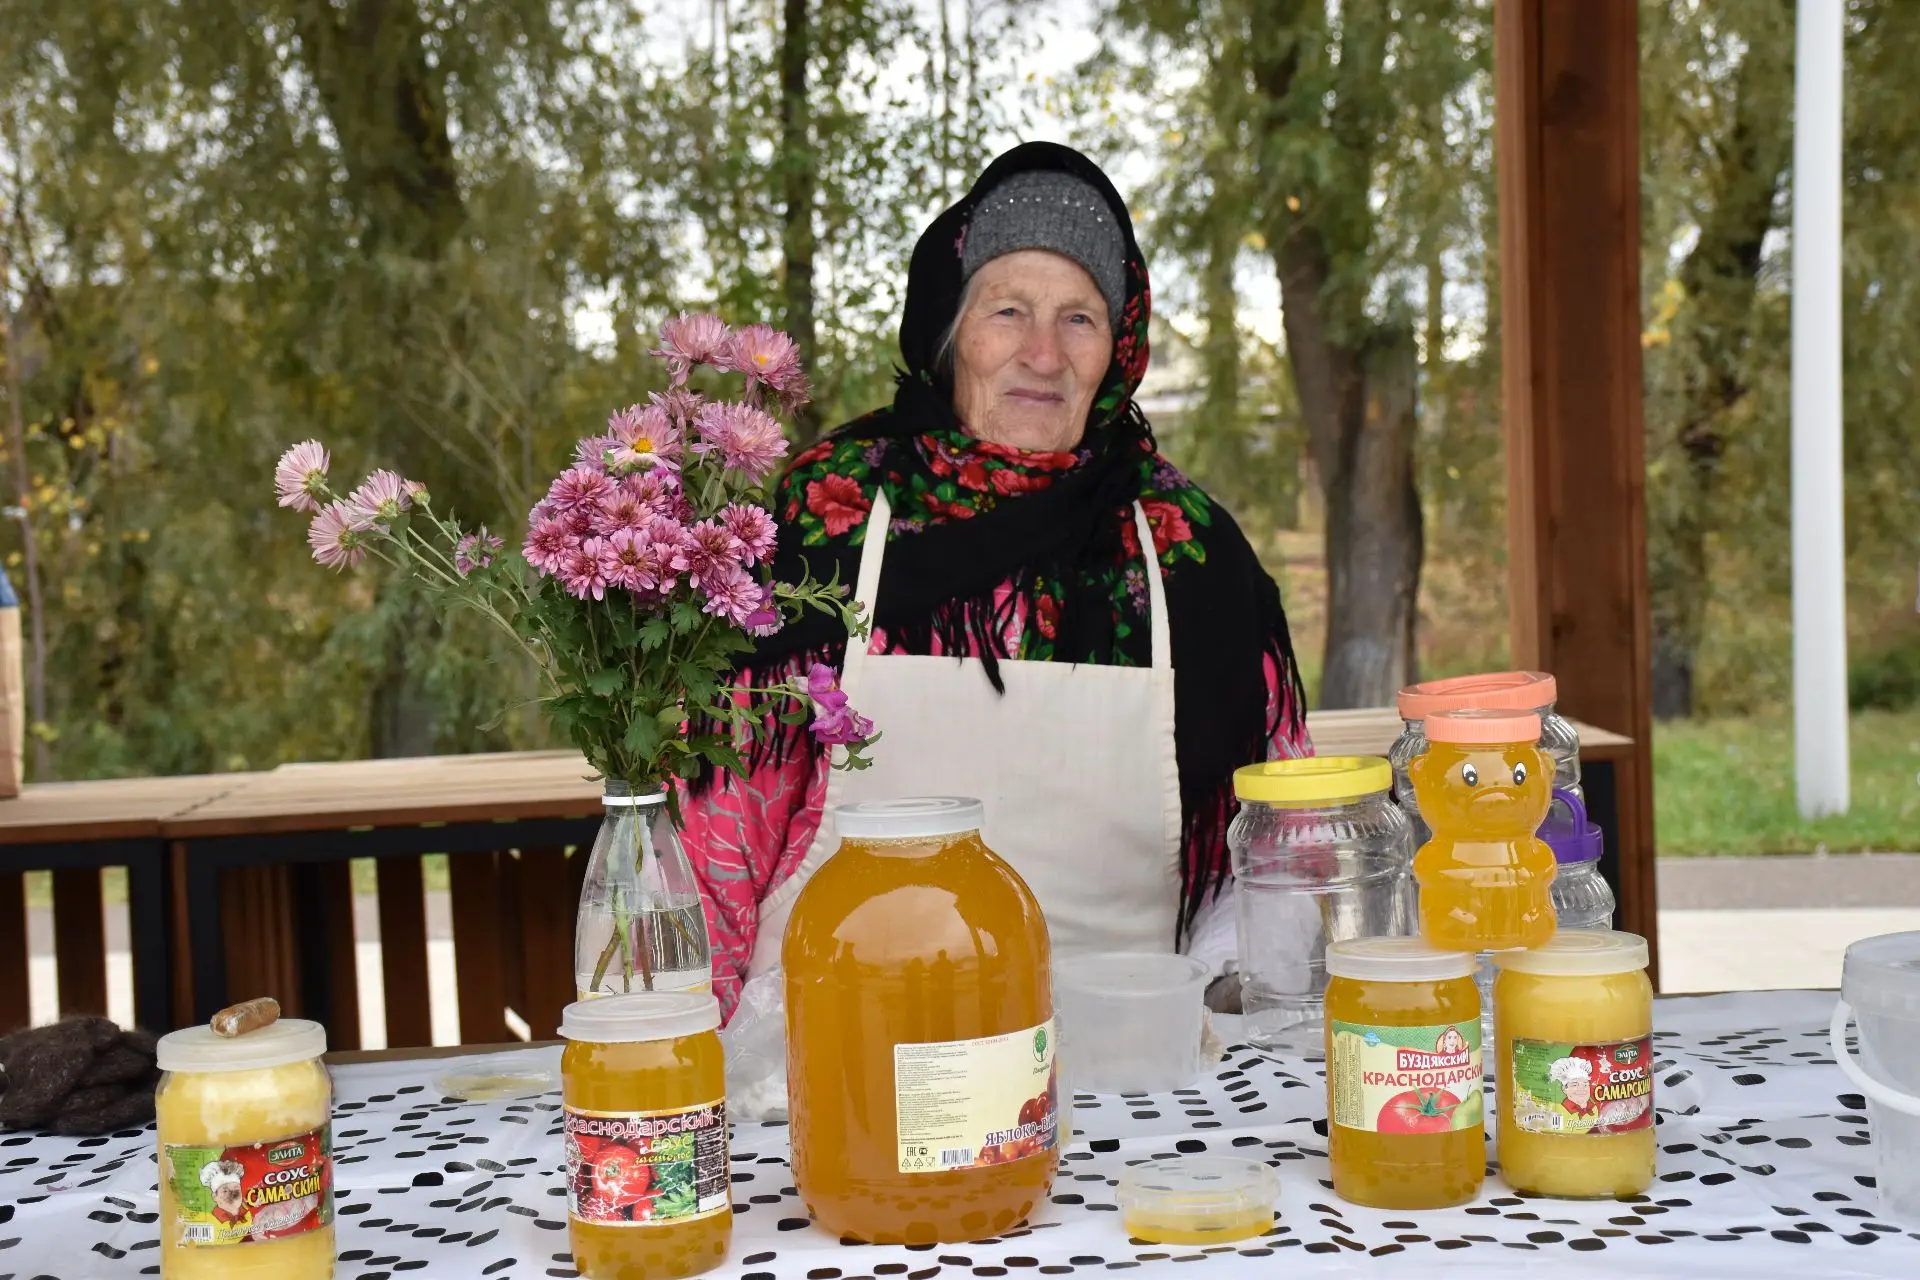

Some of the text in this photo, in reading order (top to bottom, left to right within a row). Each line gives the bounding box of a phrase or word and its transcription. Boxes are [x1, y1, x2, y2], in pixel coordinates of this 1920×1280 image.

[1609, 1066, 1645, 1083] СОУС
[271, 1148, 303, 1161] ЭЛИТА
[264, 1165, 309, 1185] СОУС
